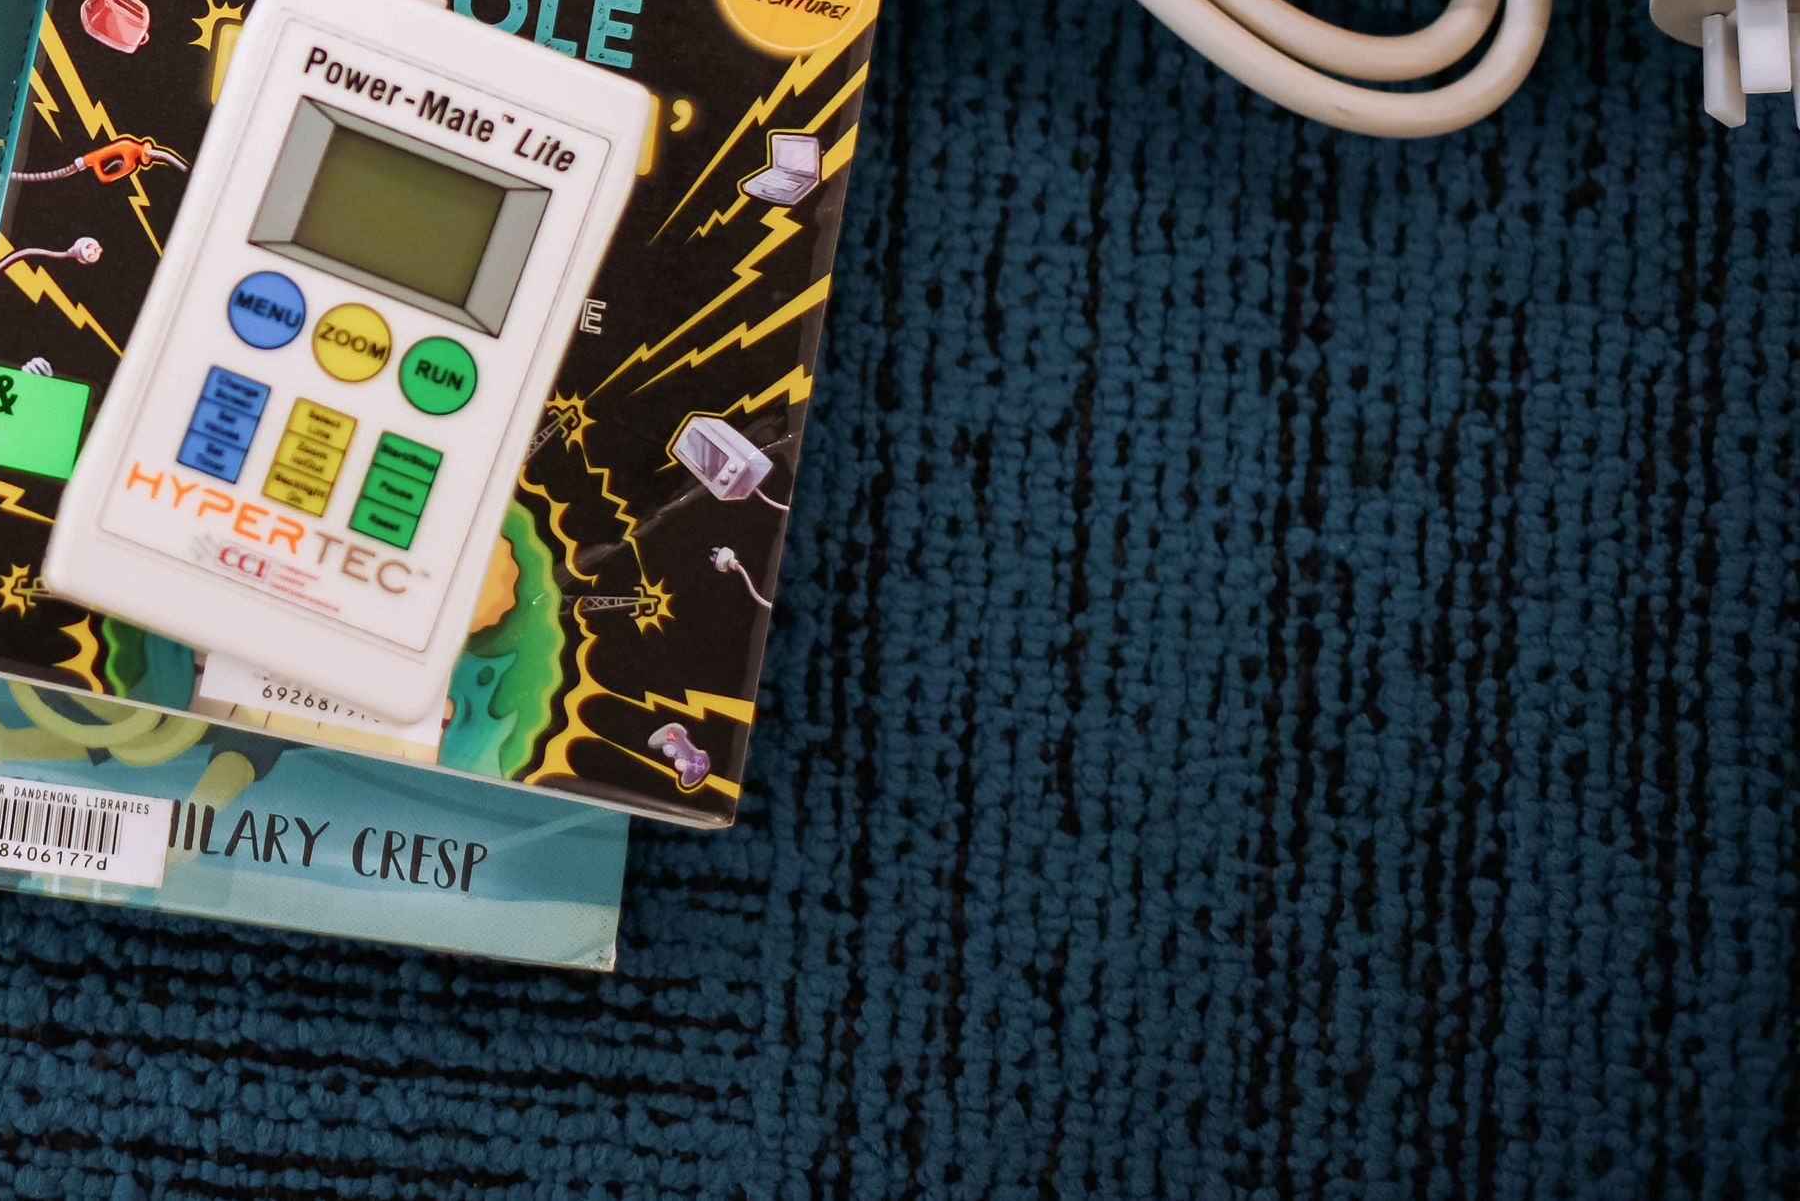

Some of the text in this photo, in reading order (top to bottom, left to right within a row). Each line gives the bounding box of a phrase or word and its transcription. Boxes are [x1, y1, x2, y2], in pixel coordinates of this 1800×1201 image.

[513, 129, 576, 173] Lite
[234, 291, 300, 328] MENU
[320, 323, 386, 361] ZOOM
[415, 360, 464, 392] RUN
[218, 546, 266, 578] CCI
[14, 786, 78, 805] DANDENONG
[85, 796, 151, 815] LIBRARIES
[352, 827, 488, 893] CRESP
